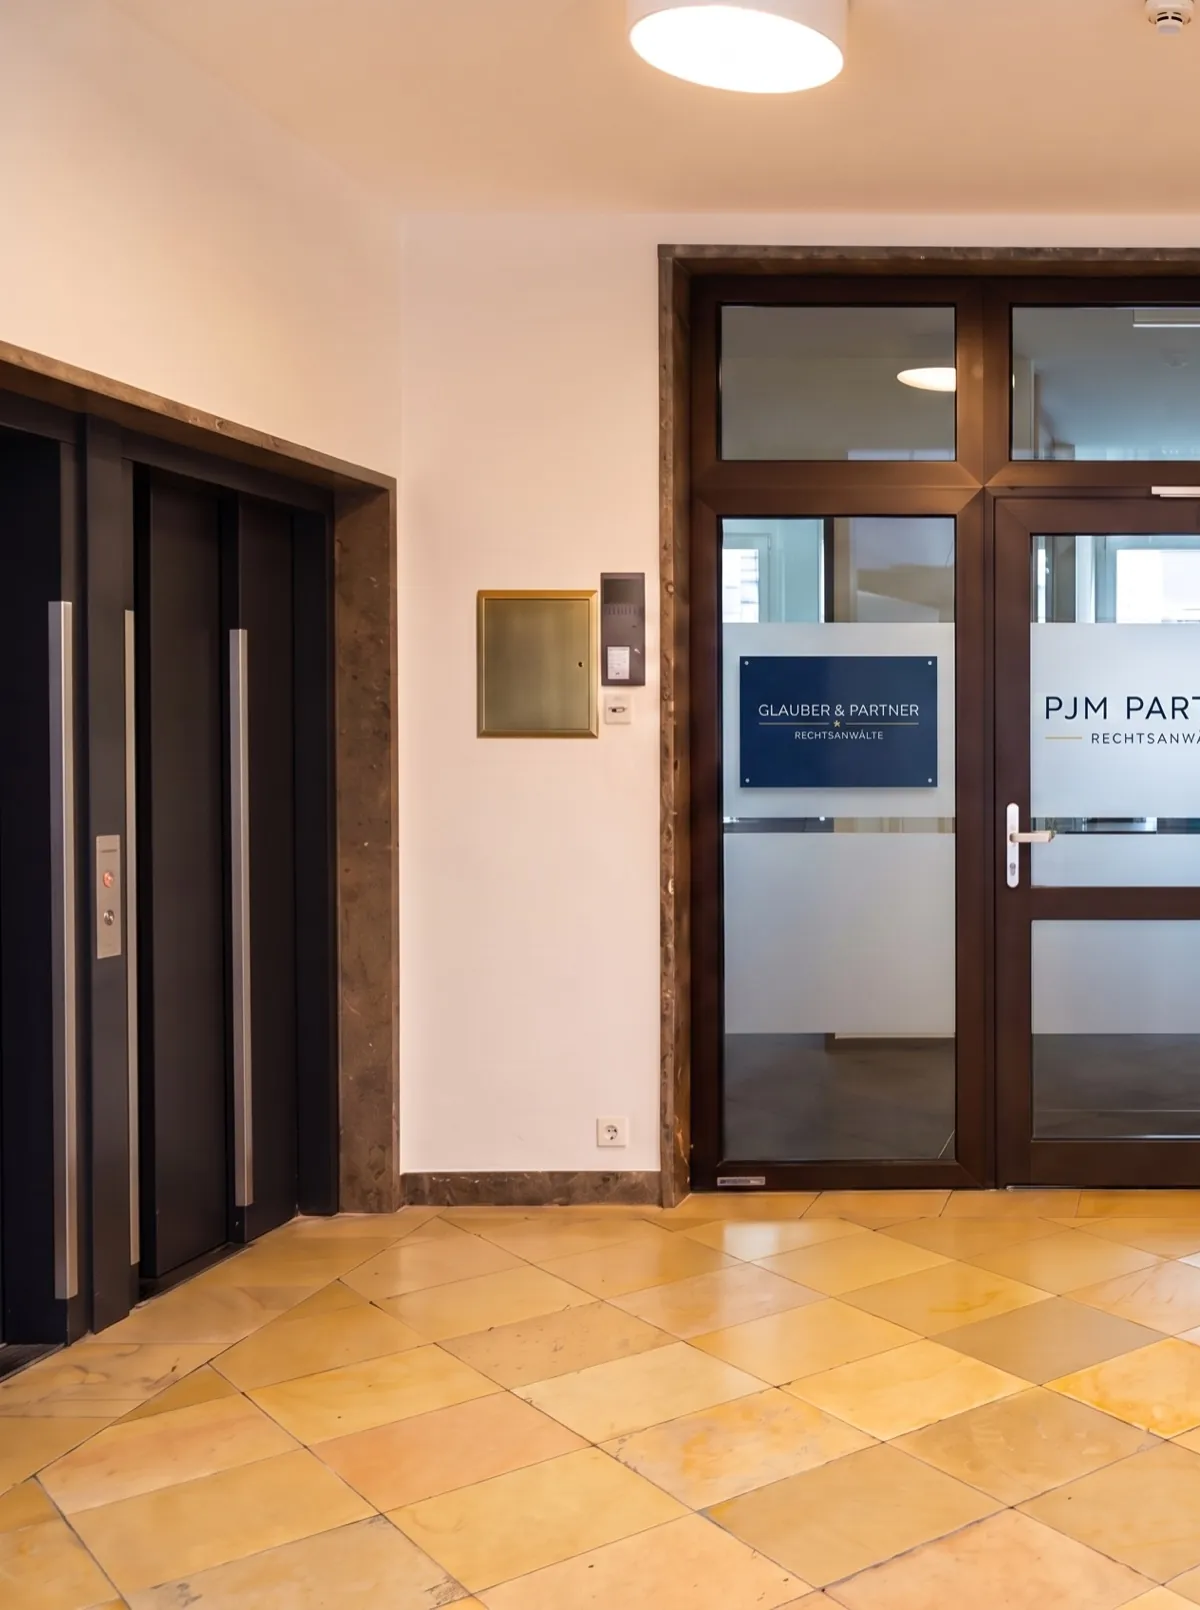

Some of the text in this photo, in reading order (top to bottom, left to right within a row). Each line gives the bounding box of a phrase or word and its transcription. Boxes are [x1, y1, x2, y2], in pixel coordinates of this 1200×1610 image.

[758, 704, 919, 717] GLAUBER & PARTNER
[1045, 696, 1107, 720] PJM
